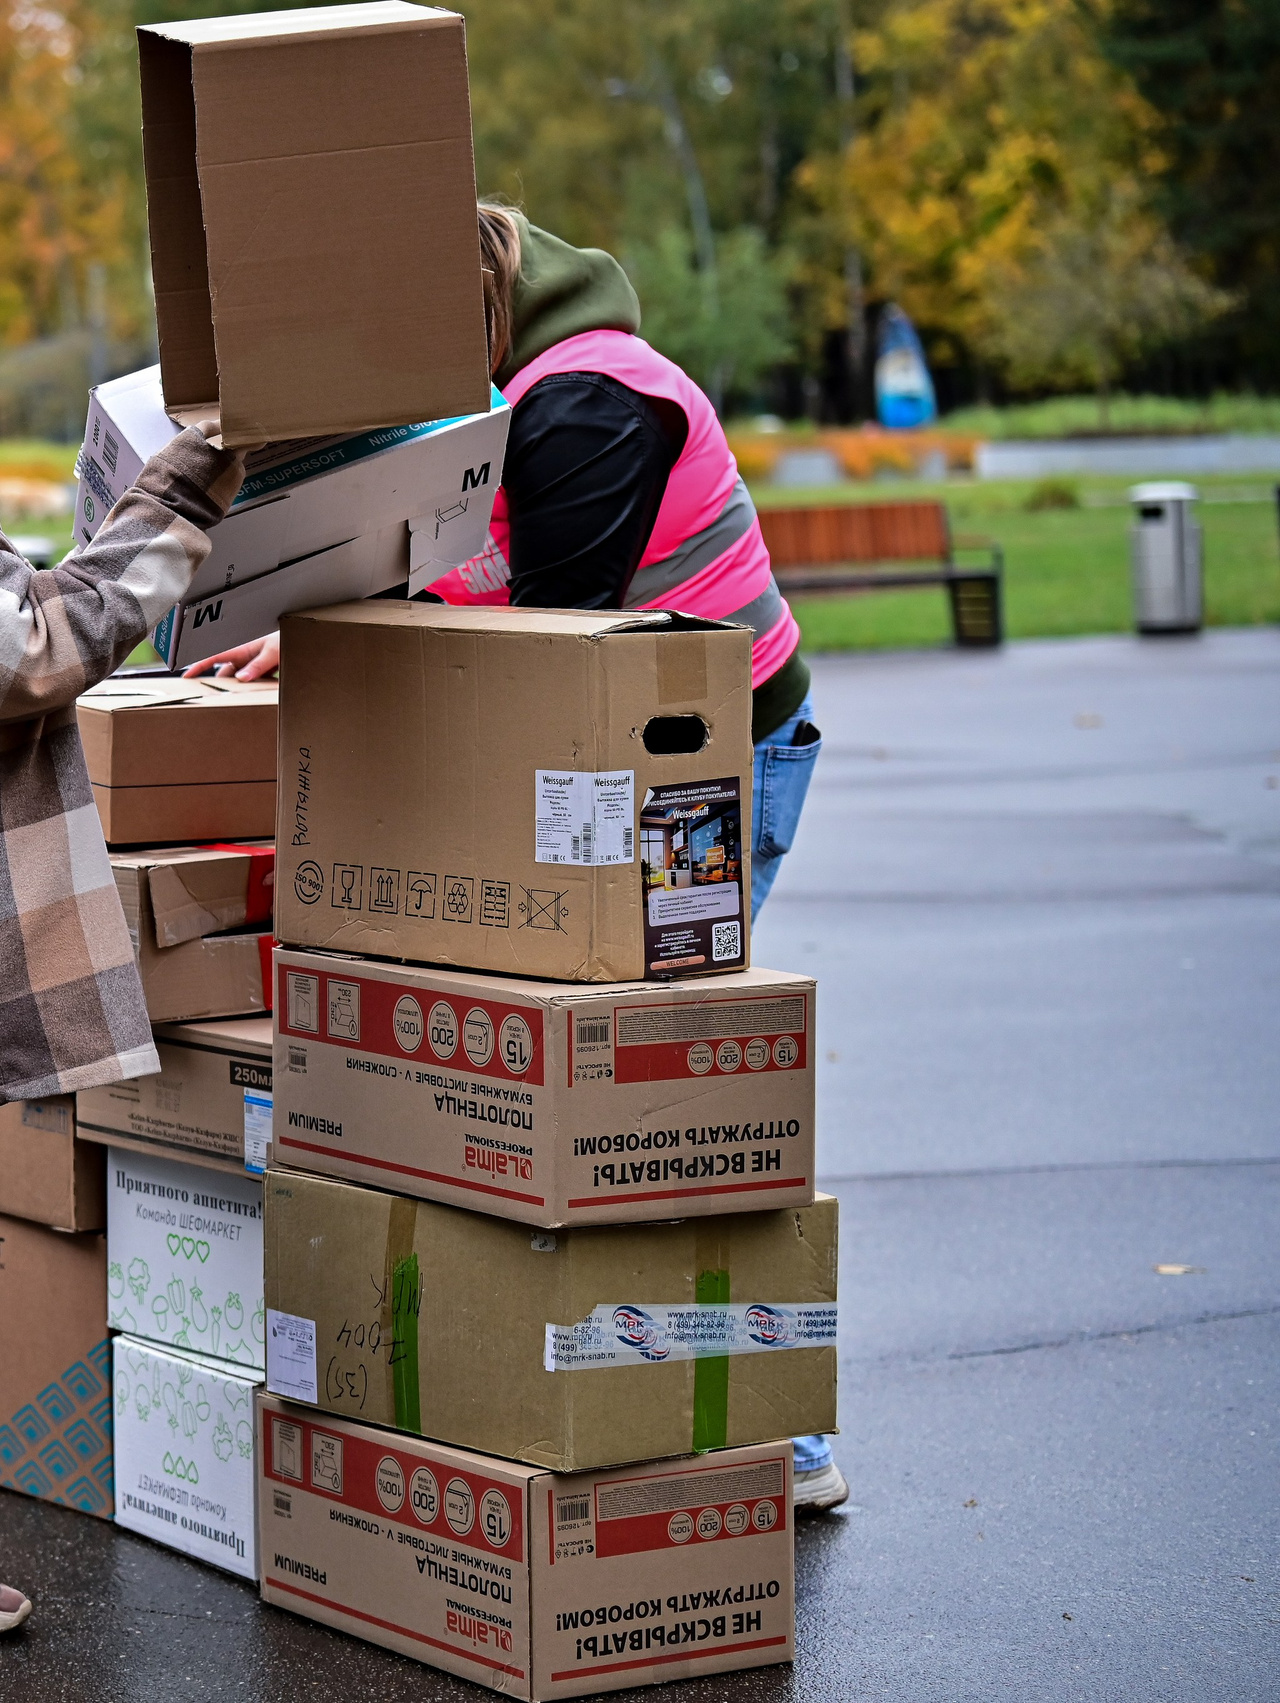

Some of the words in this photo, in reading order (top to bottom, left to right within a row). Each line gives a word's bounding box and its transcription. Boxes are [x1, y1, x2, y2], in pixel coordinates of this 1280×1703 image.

[368, 428, 408, 446] Nitrile
[461, 461, 491, 492] M
[542, 775, 574, 787] Weissgauff
[593, 776, 630, 788] Weissgauff
[672, 805, 710, 819] Weissgauff
[295, 872, 307, 885] ISO
[307, 877, 324, 894] 9001
[666, 958, 689, 967] WELCOME
[396, 1020, 420, 1036] 100%
[432, 1027, 454, 1047] 200
[478, 1036, 483, 1046] 2
[506, 1040, 528, 1066] 15
[346, 1057, 398, 1079] СЛОЖЕНИЯ
[720, 1054, 738, 1065] 200
[778, 1050, 794, 1063] 15
[404, 1069, 412, 1082] V
[415, 1071, 469, 1092] ЛИСТОВЫЕ
[470, 1082, 533, 1106] БУМАЖНЫЕ
[433, 1090, 533, 1131] ПОЛОТЕНЦА
[288, 1111, 343, 1137] PREMIUM
[685, 1119, 800, 1146] ОТГРУЖАТЬ
[464, 1133, 533, 1157] PROFESSIONAL
[573, 1129, 680, 1156] КОРОБОМ!
[464, 1146, 518, 1180] Laima
[593, 1152, 746, 1187] ВСКРЫВАТЬ!
[751, 1149, 781, 1173] НЕ
[116, 1170, 189, 1203] Приятного
[193, 1193, 262, 1220] аппетита!
[136, 1202, 177, 1226] Команда
[179, 1213, 243, 1241] ШЕФМАРКЕТ
[550, 1351, 616, 1364] info@mrk-snab.ru
[558, 1342, 578, 1352] (499)
[138, 1474, 189, 1507] ШЕФМАРКЕТ
[378, 1479, 402, 1498] 100%
[412, 1489, 435, 1512] 200
[122, 1492, 178, 1526] аппетита!
[191, 1494, 227, 1522] Команда
[458, 1505, 464, 1515] 2
[757, 1513, 772, 1526] 15
[329, 1508, 380, 1536] СЛОЖЕНИЯ
[486, 1513, 507, 1541] 15
[670, 1524, 691, 1534] 100%
[700, 1521, 718, 1532] 200
[180, 1516, 245, 1558] Приятного
[386, 1528, 395, 1542] V
[397, 1531, 449, 1557] ЛИСТОВЫЕ
[274, 1552, 327, 1586] PREMIUM
[451, 1550, 512, 1580] БУМАЖНЫЕ
[414, 1554, 512, 1605] ПОЛОТЕНЦА
[666, 1580, 780, 1613] ОТГРУЖАТЬ
[446, 1599, 512, 1630] PROFESSIONAL
[555, 1598, 662, 1632] КОРОБОМ!
[732, 1610, 762, 1635] НЕ
[446, 1610, 499, 1647] Laima
[575, 1615, 727, 1660] ВСКРЫВАТЬ!
